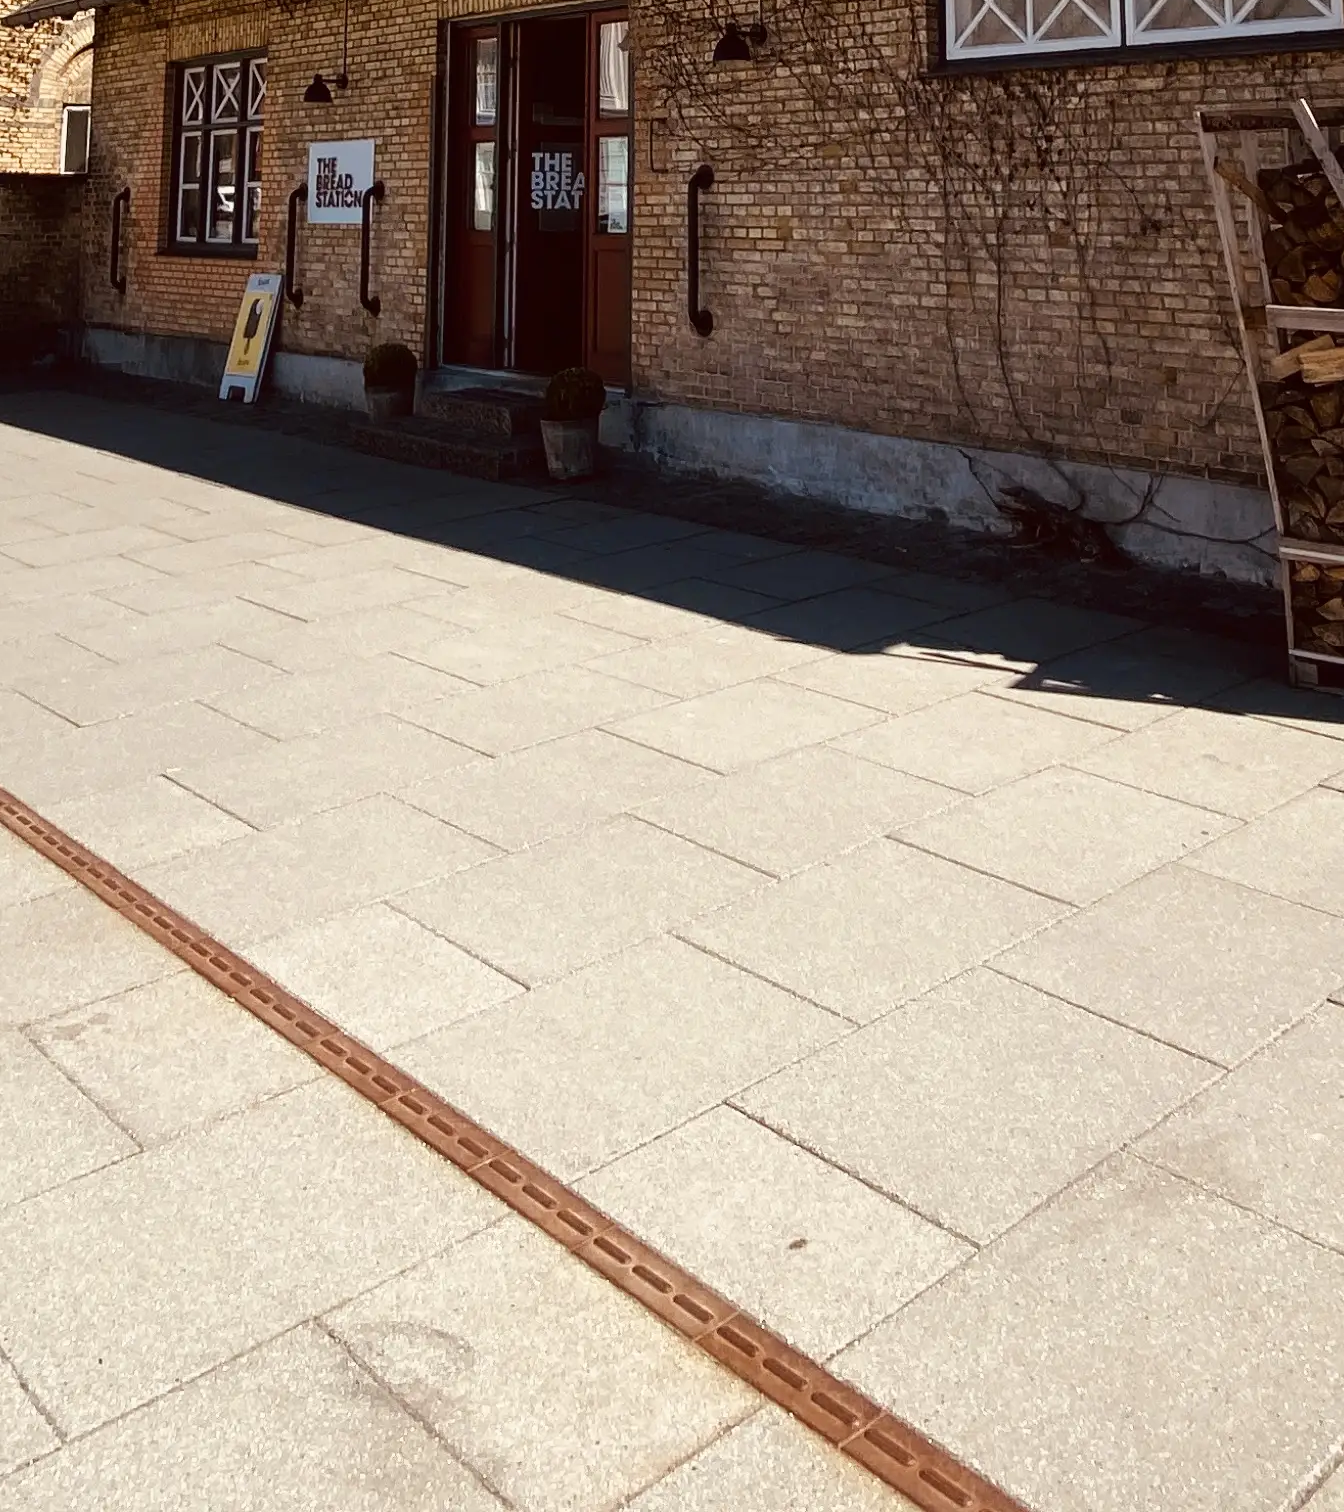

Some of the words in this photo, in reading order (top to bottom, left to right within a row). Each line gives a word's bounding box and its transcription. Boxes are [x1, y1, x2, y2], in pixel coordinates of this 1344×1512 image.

[317, 157, 337, 174] THE
[531, 152, 572, 172] THE
[316, 173, 353, 190] BREAD
[531, 171, 586, 190] BREA
[315, 189, 363, 208] STATION
[531, 190, 584, 210] STAT
